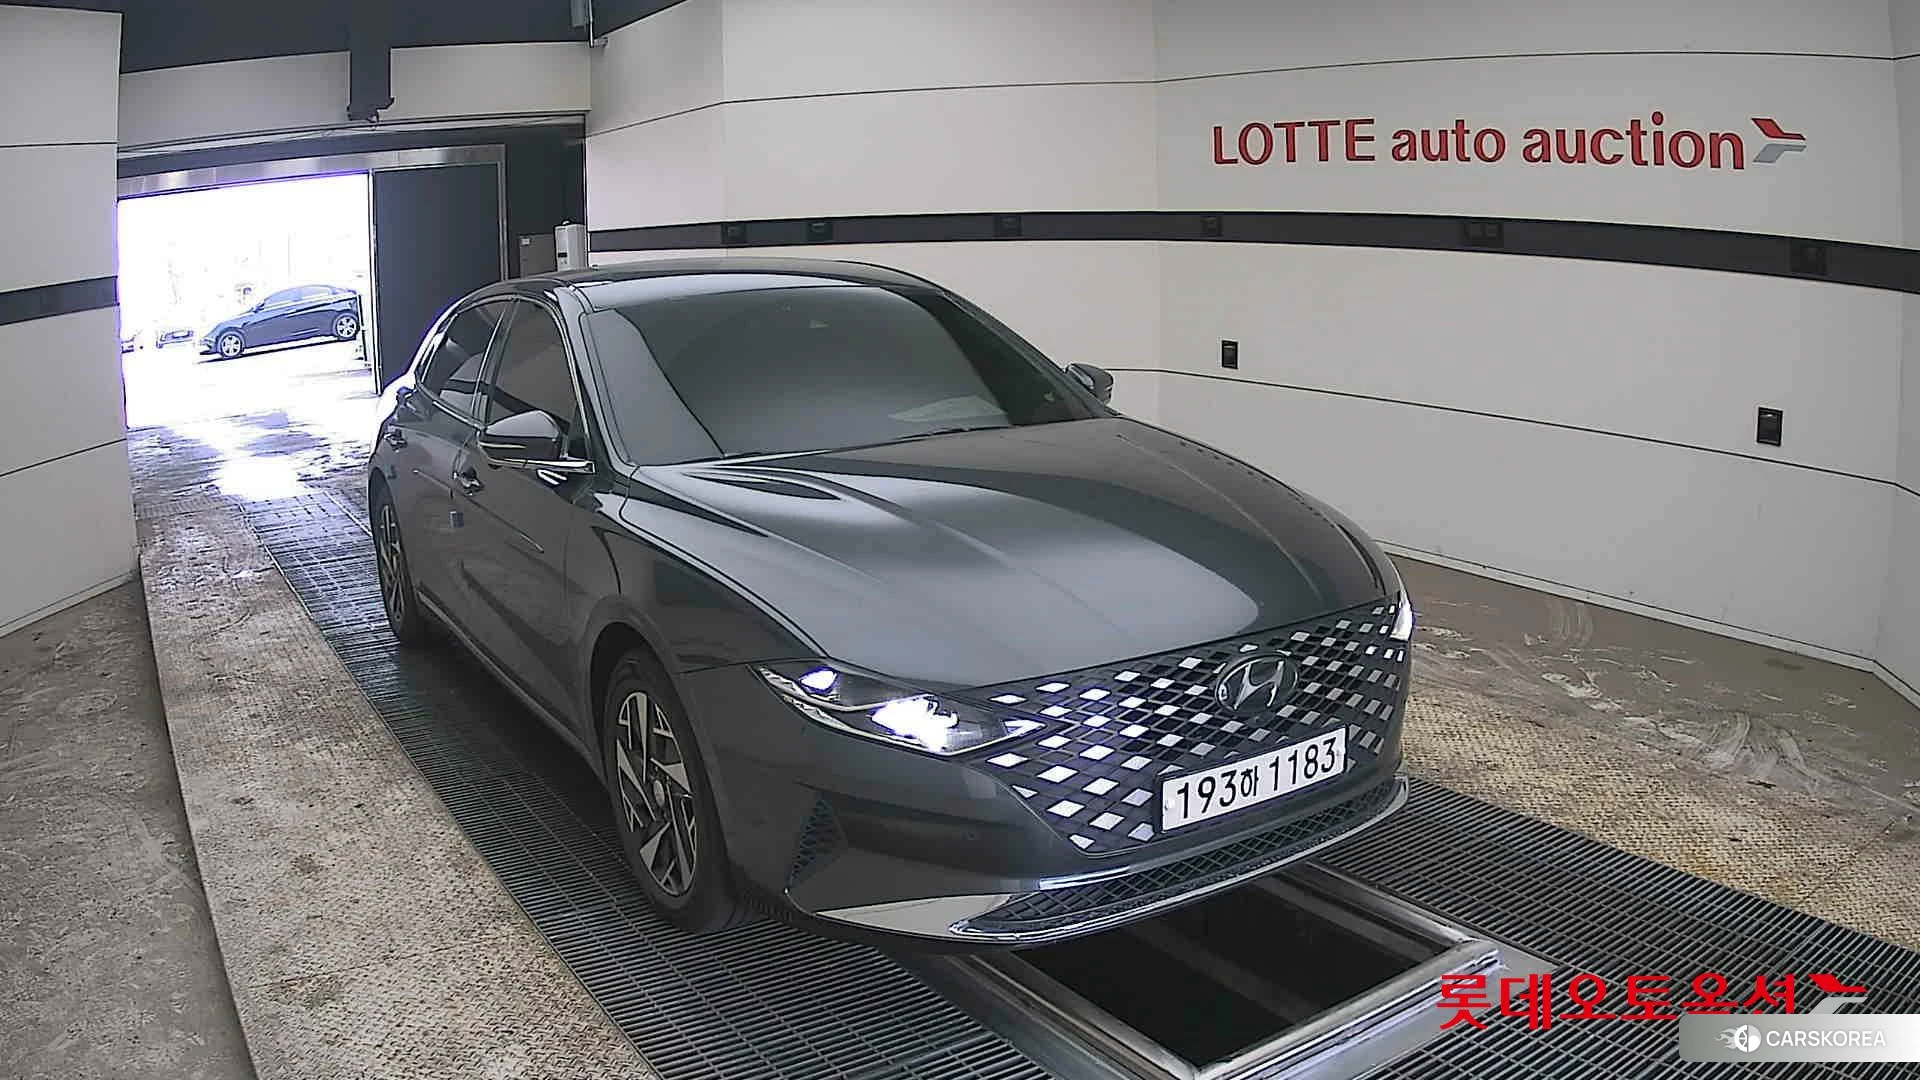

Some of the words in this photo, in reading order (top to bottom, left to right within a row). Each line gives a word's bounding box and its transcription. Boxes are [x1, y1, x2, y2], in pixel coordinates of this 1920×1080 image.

[1213, 118, 1376, 165] LOTTE
[1391, 118, 1507, 163] auto
[1521, 111, 1746, 170] auction
[1177, 765, 1259, 819] 193하
[1269, 736, 1338, 792] 1183
